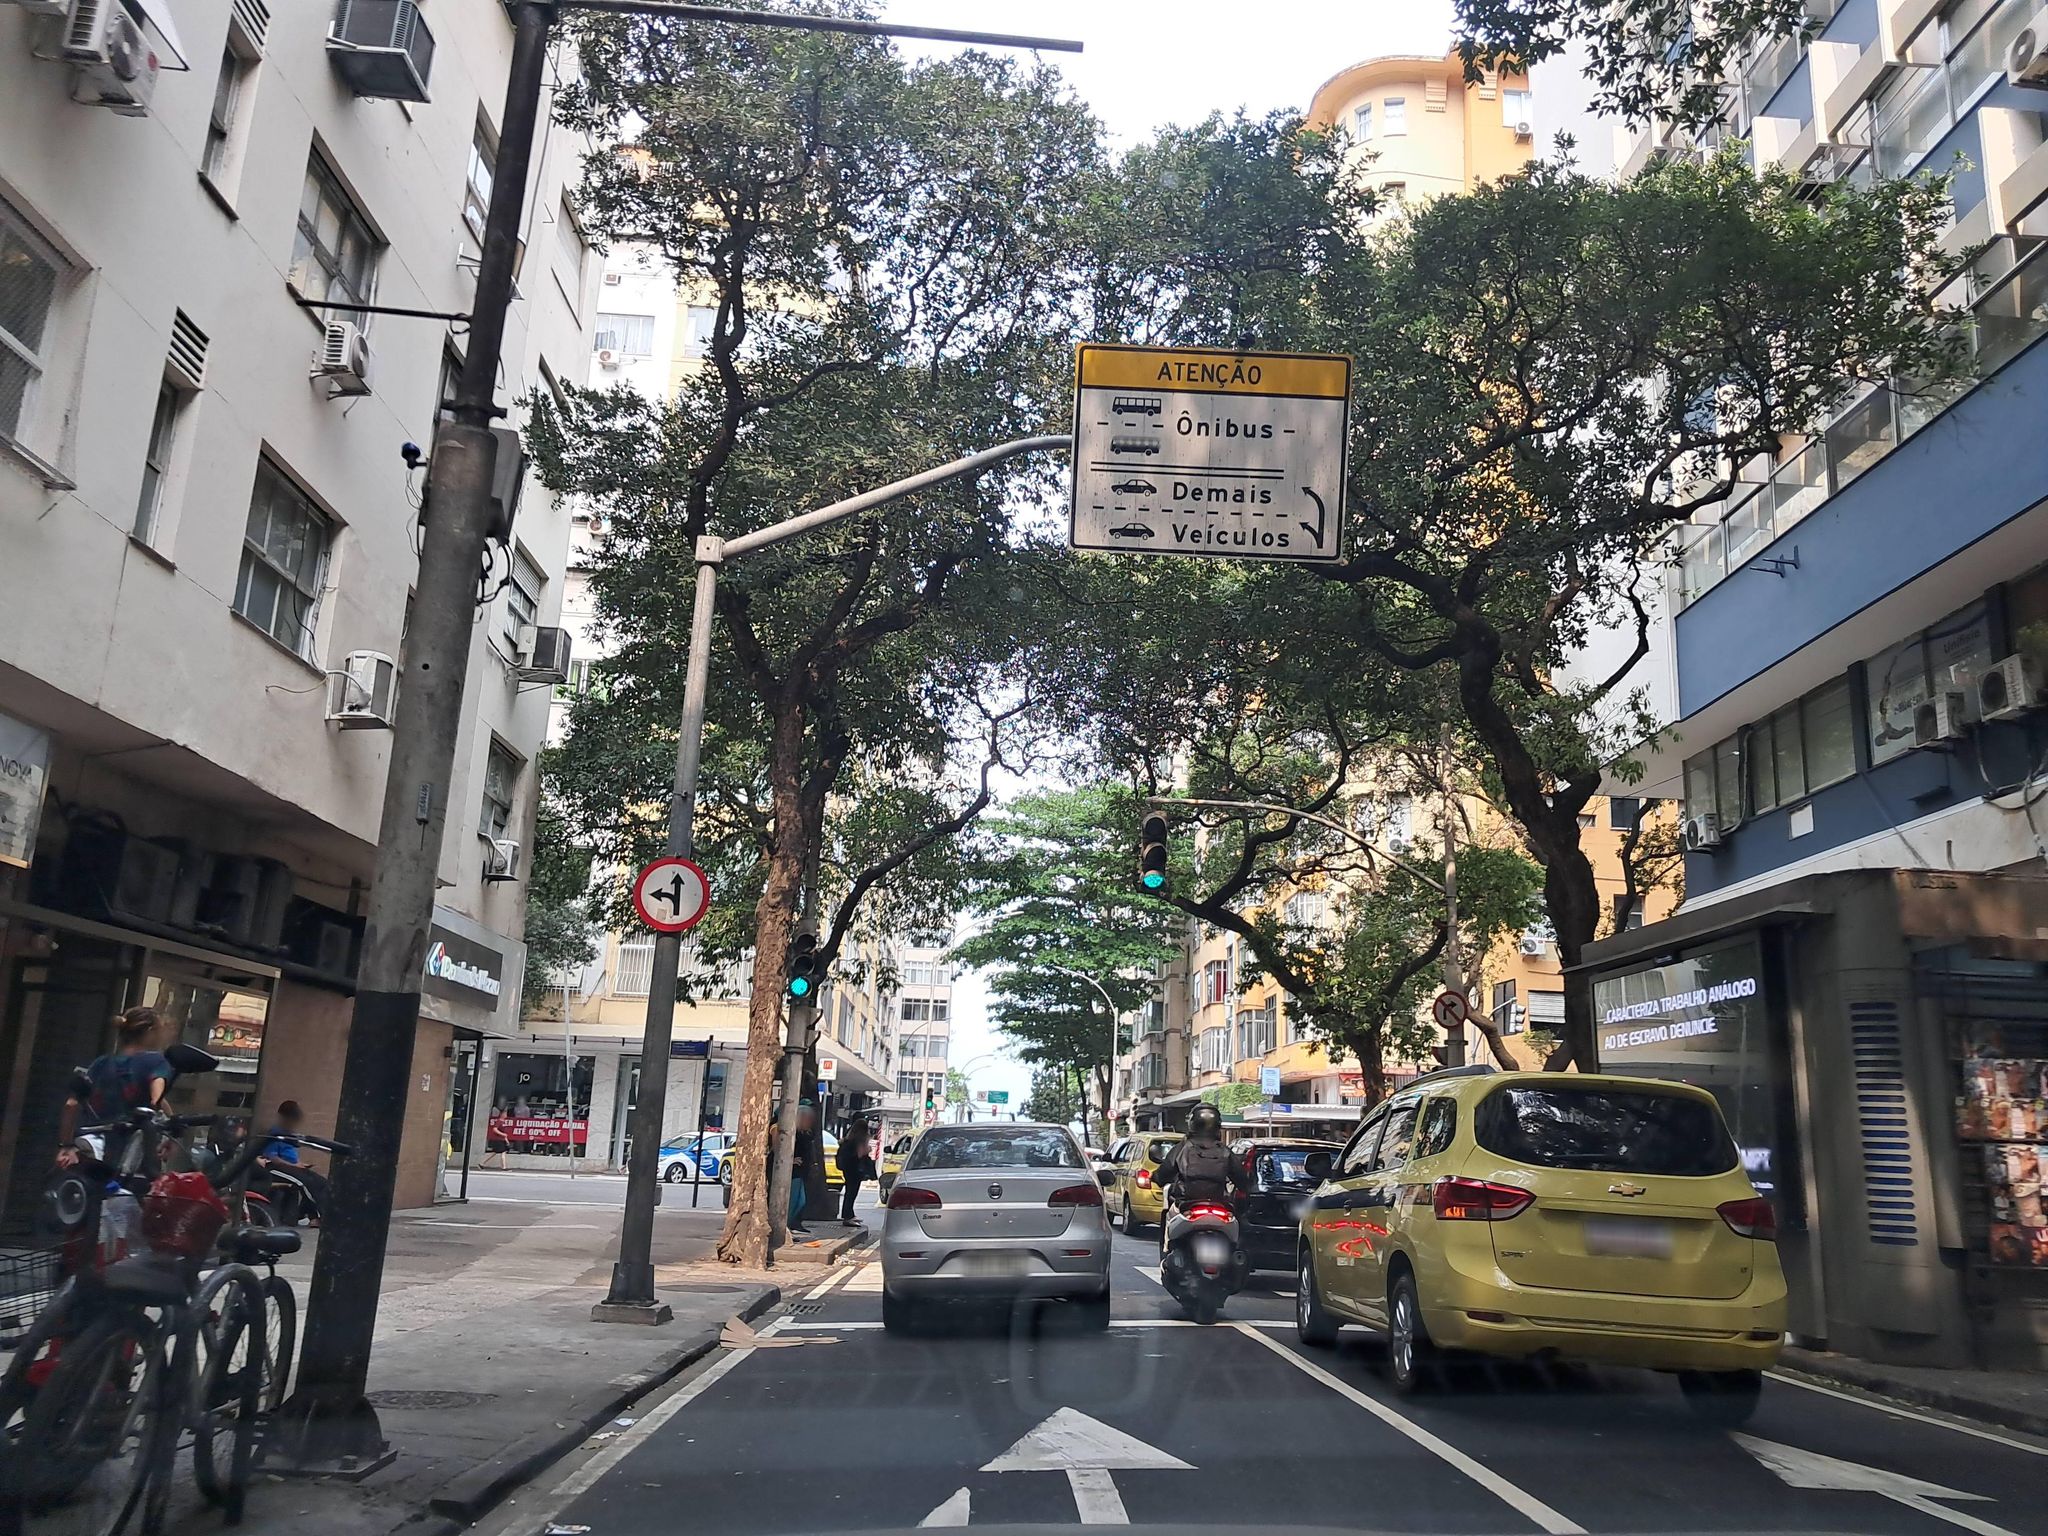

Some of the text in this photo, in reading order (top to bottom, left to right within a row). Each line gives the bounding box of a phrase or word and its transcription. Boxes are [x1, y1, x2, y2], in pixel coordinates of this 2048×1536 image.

[1157, 359, 1262, 388] ATENÇÃO
[1176, 410, 1273, 439] Ônibus
[1172, 481, 1272, 504] Demais
[1172, 521, 1290, 547] Veículos
[1660, 988, 1708, 1013] TRABALHO
[1708, 977, 1757, 1003] ANÁLOGO
[1604, 1034, 1616, 1050] AO
[1617, 1033, 1629, 1049] DE
[513, 1126, 527, 1136] ATÉ
[548, 1129, 561, 1137] OFF
[516, 1119, 560, 1130] LIQUIDAÇÃO
